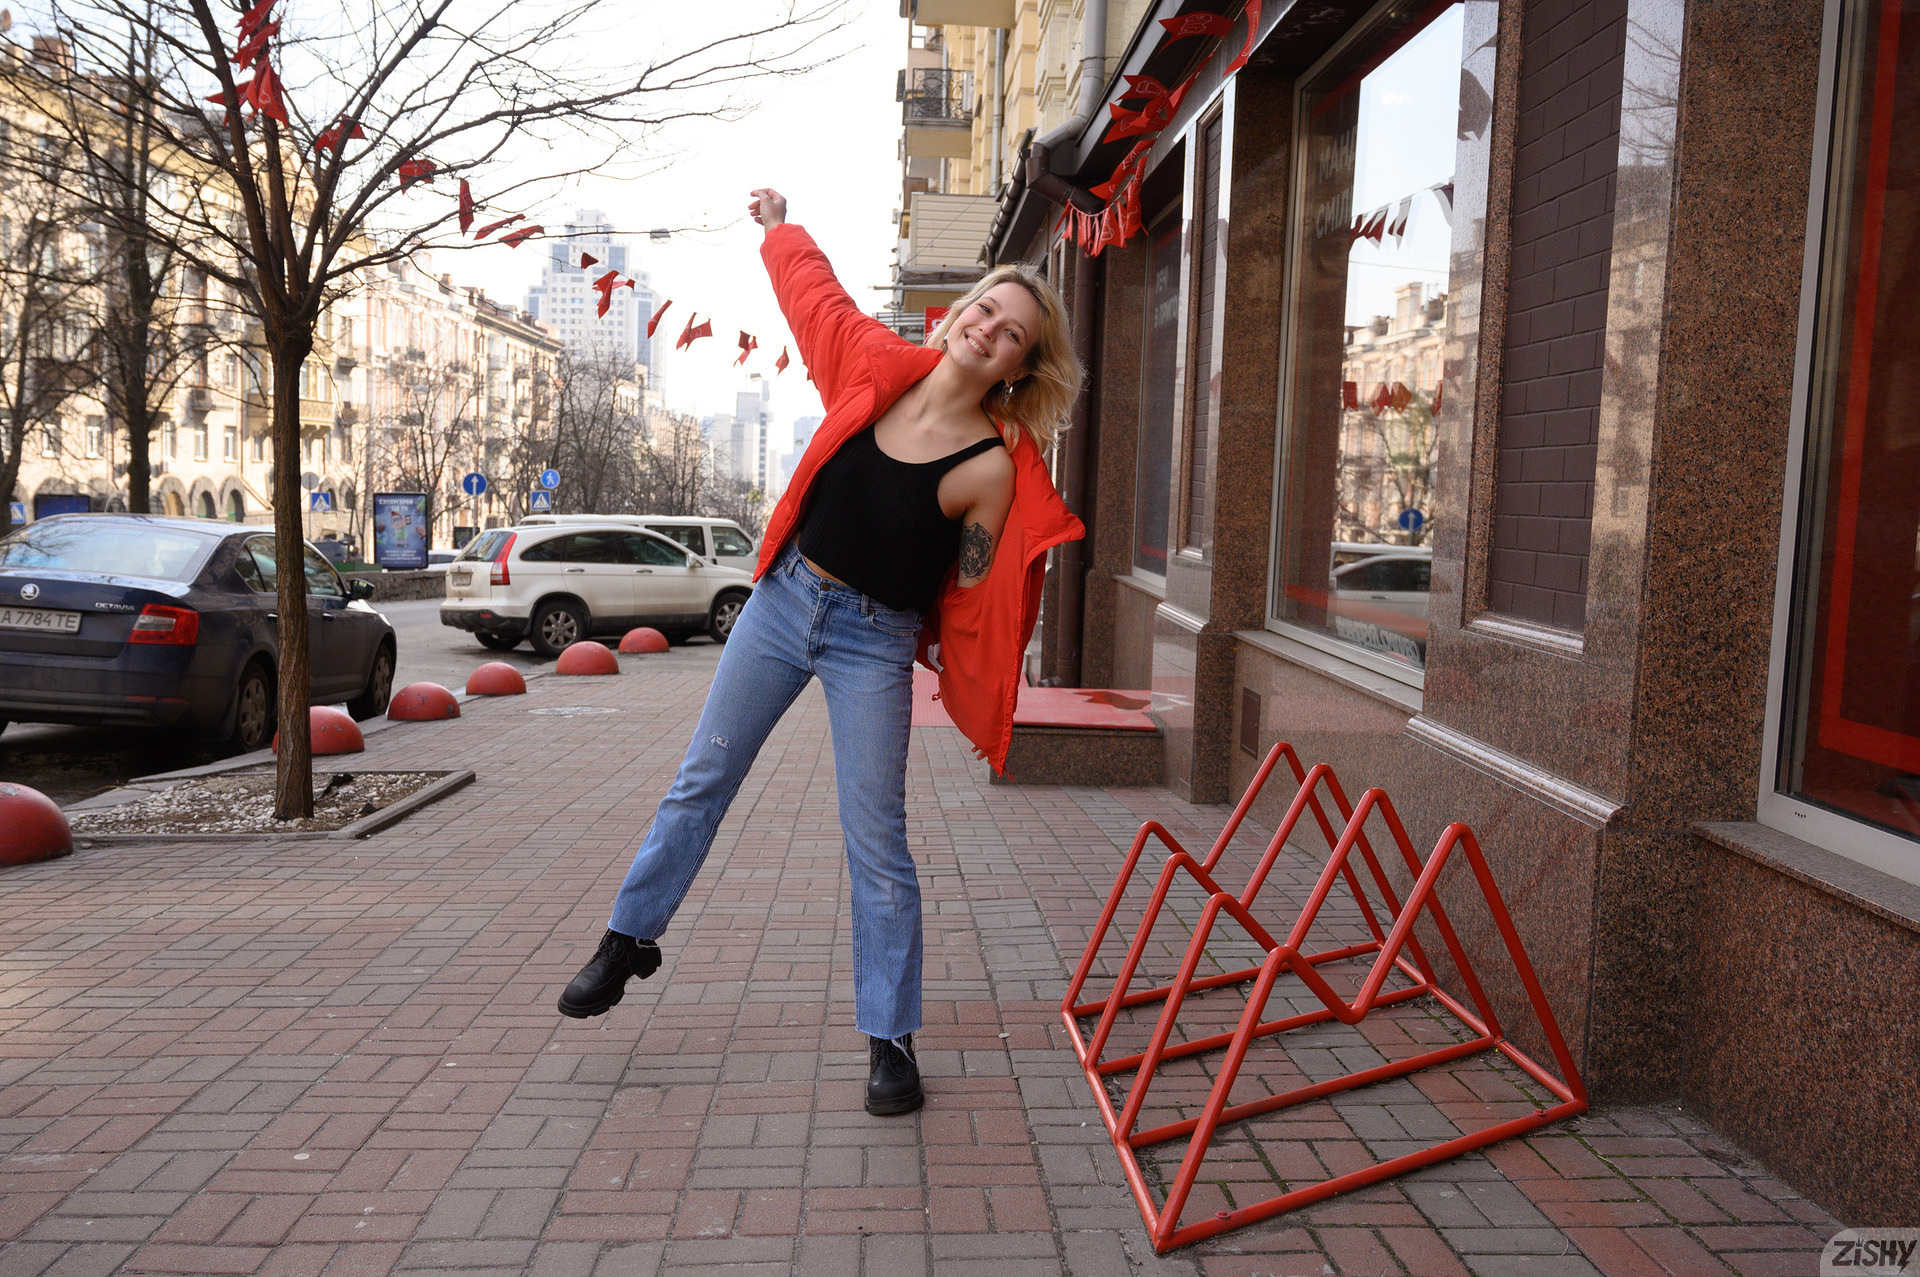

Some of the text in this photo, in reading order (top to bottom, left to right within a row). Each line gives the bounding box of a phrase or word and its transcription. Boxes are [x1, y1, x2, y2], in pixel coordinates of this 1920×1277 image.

[95, 602, 135, 611] OCTAVIA
[15, 610, 52, 627] 7784
[56, 613, 78, 629] TE
